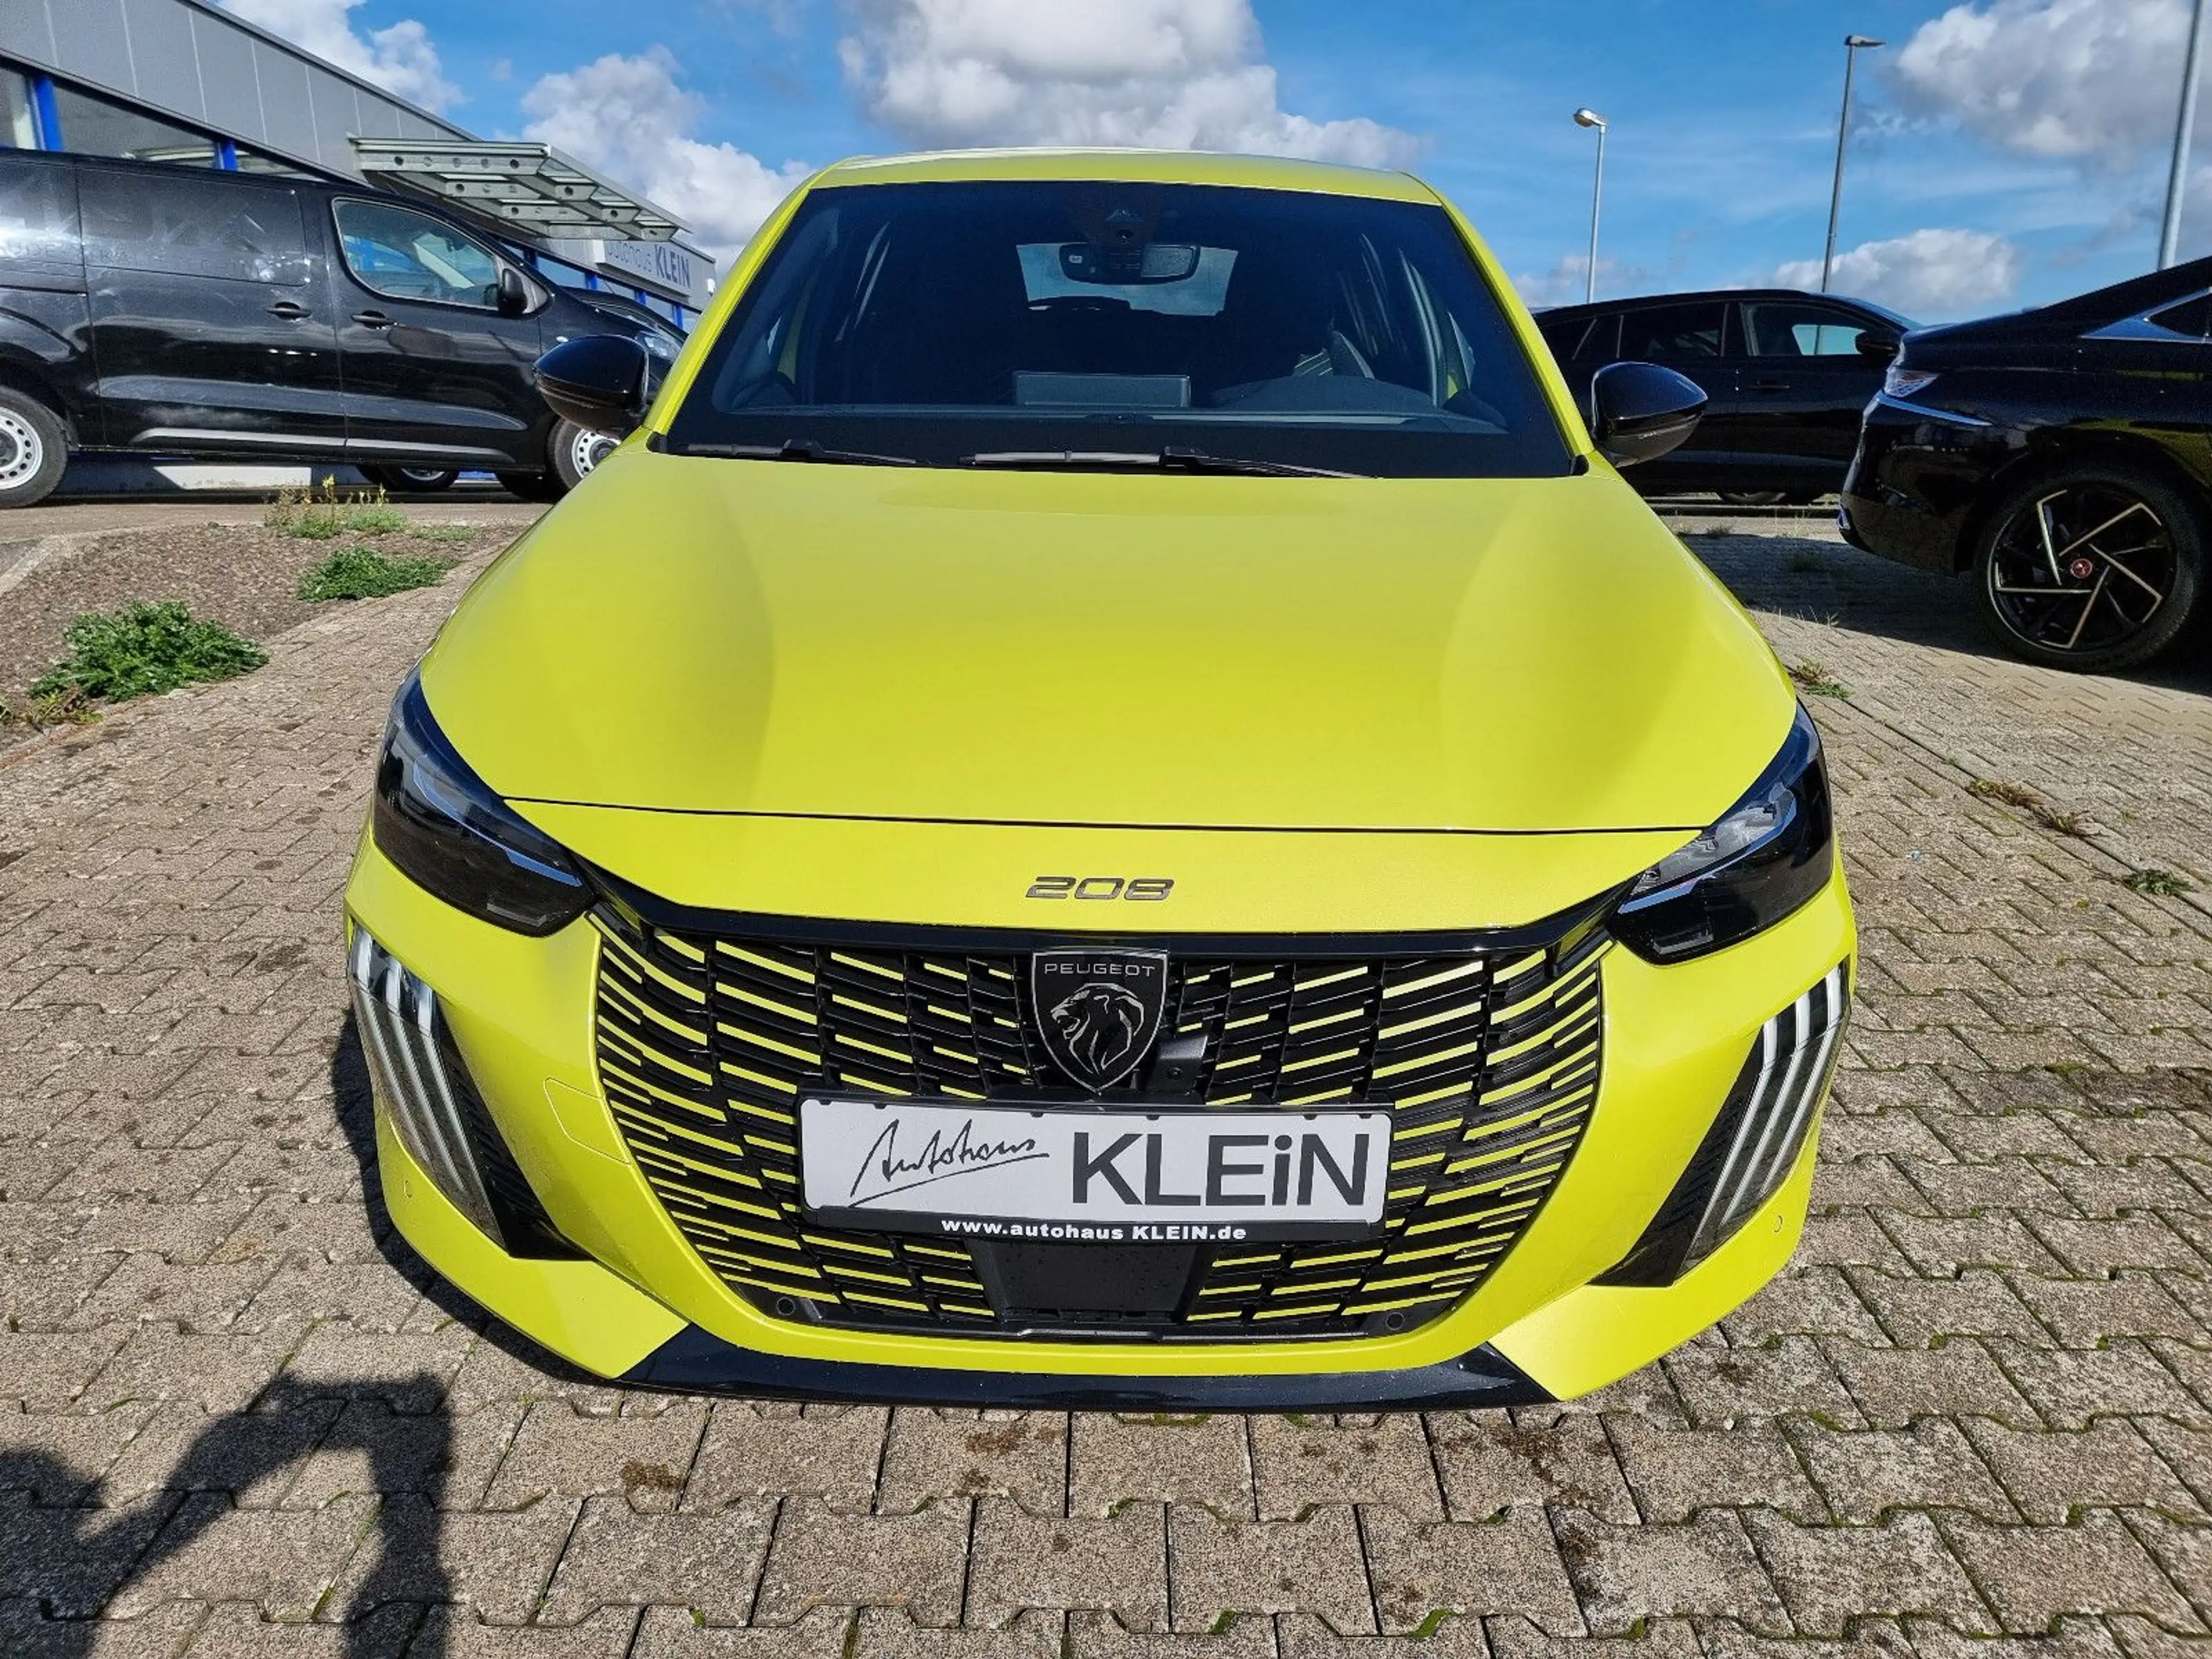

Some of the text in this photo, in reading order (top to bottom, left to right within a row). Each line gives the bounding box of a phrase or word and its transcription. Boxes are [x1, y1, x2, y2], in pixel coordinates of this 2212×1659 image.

[654, 244, 691, 288] KLEIN
[1025, 876, 1175, 901] 208
[1044, 963, 1156, 978] PEUGEOT
[850, 1119, 1036, 1198] Autohaus
[941, 1219, 1247, 1240] www.autohaus KLEIN.de
